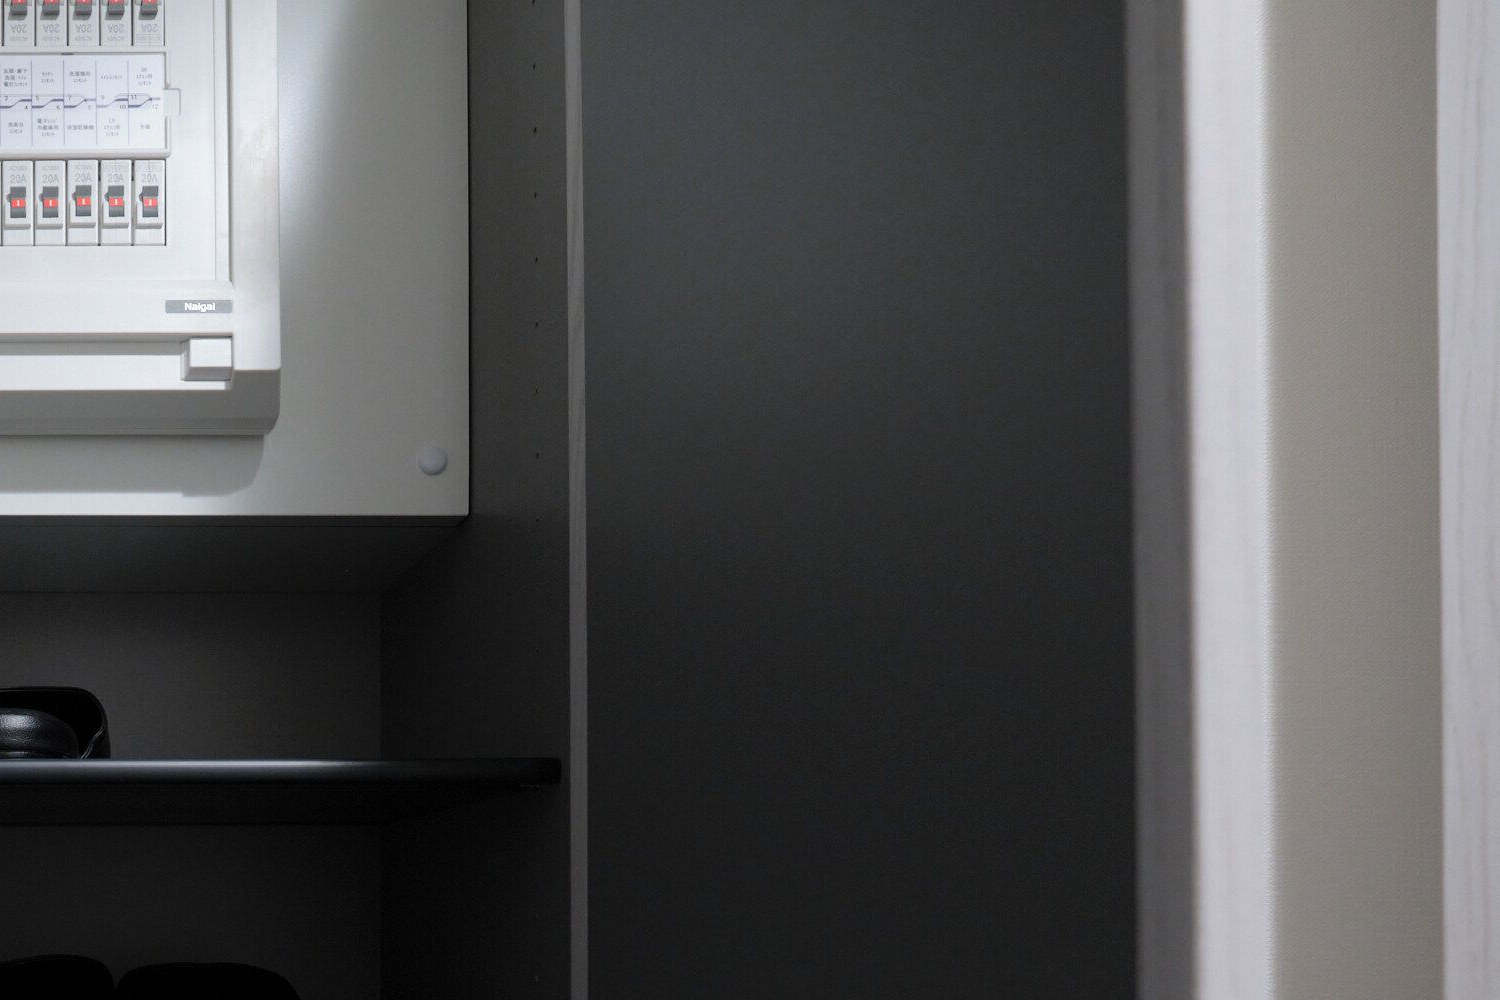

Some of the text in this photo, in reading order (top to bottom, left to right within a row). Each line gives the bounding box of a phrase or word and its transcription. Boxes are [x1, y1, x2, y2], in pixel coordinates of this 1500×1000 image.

[11, 24, 27, 33] 20A
[43, 24, 60, 33] 20A
[75, 24, 92, 33] 20A
[108, 24, 124, 33] 20A
[141, 24, 158, 33] 20A
[10, 174, 27, 184] 20A
[42, 174, 59, 183] 20A
[75, 173, 92, 182] 20A
[107, 173, 124, 183] 20A
[141, 173, 158, 183] 20A
[184, 302, 216, 313] Naigai
